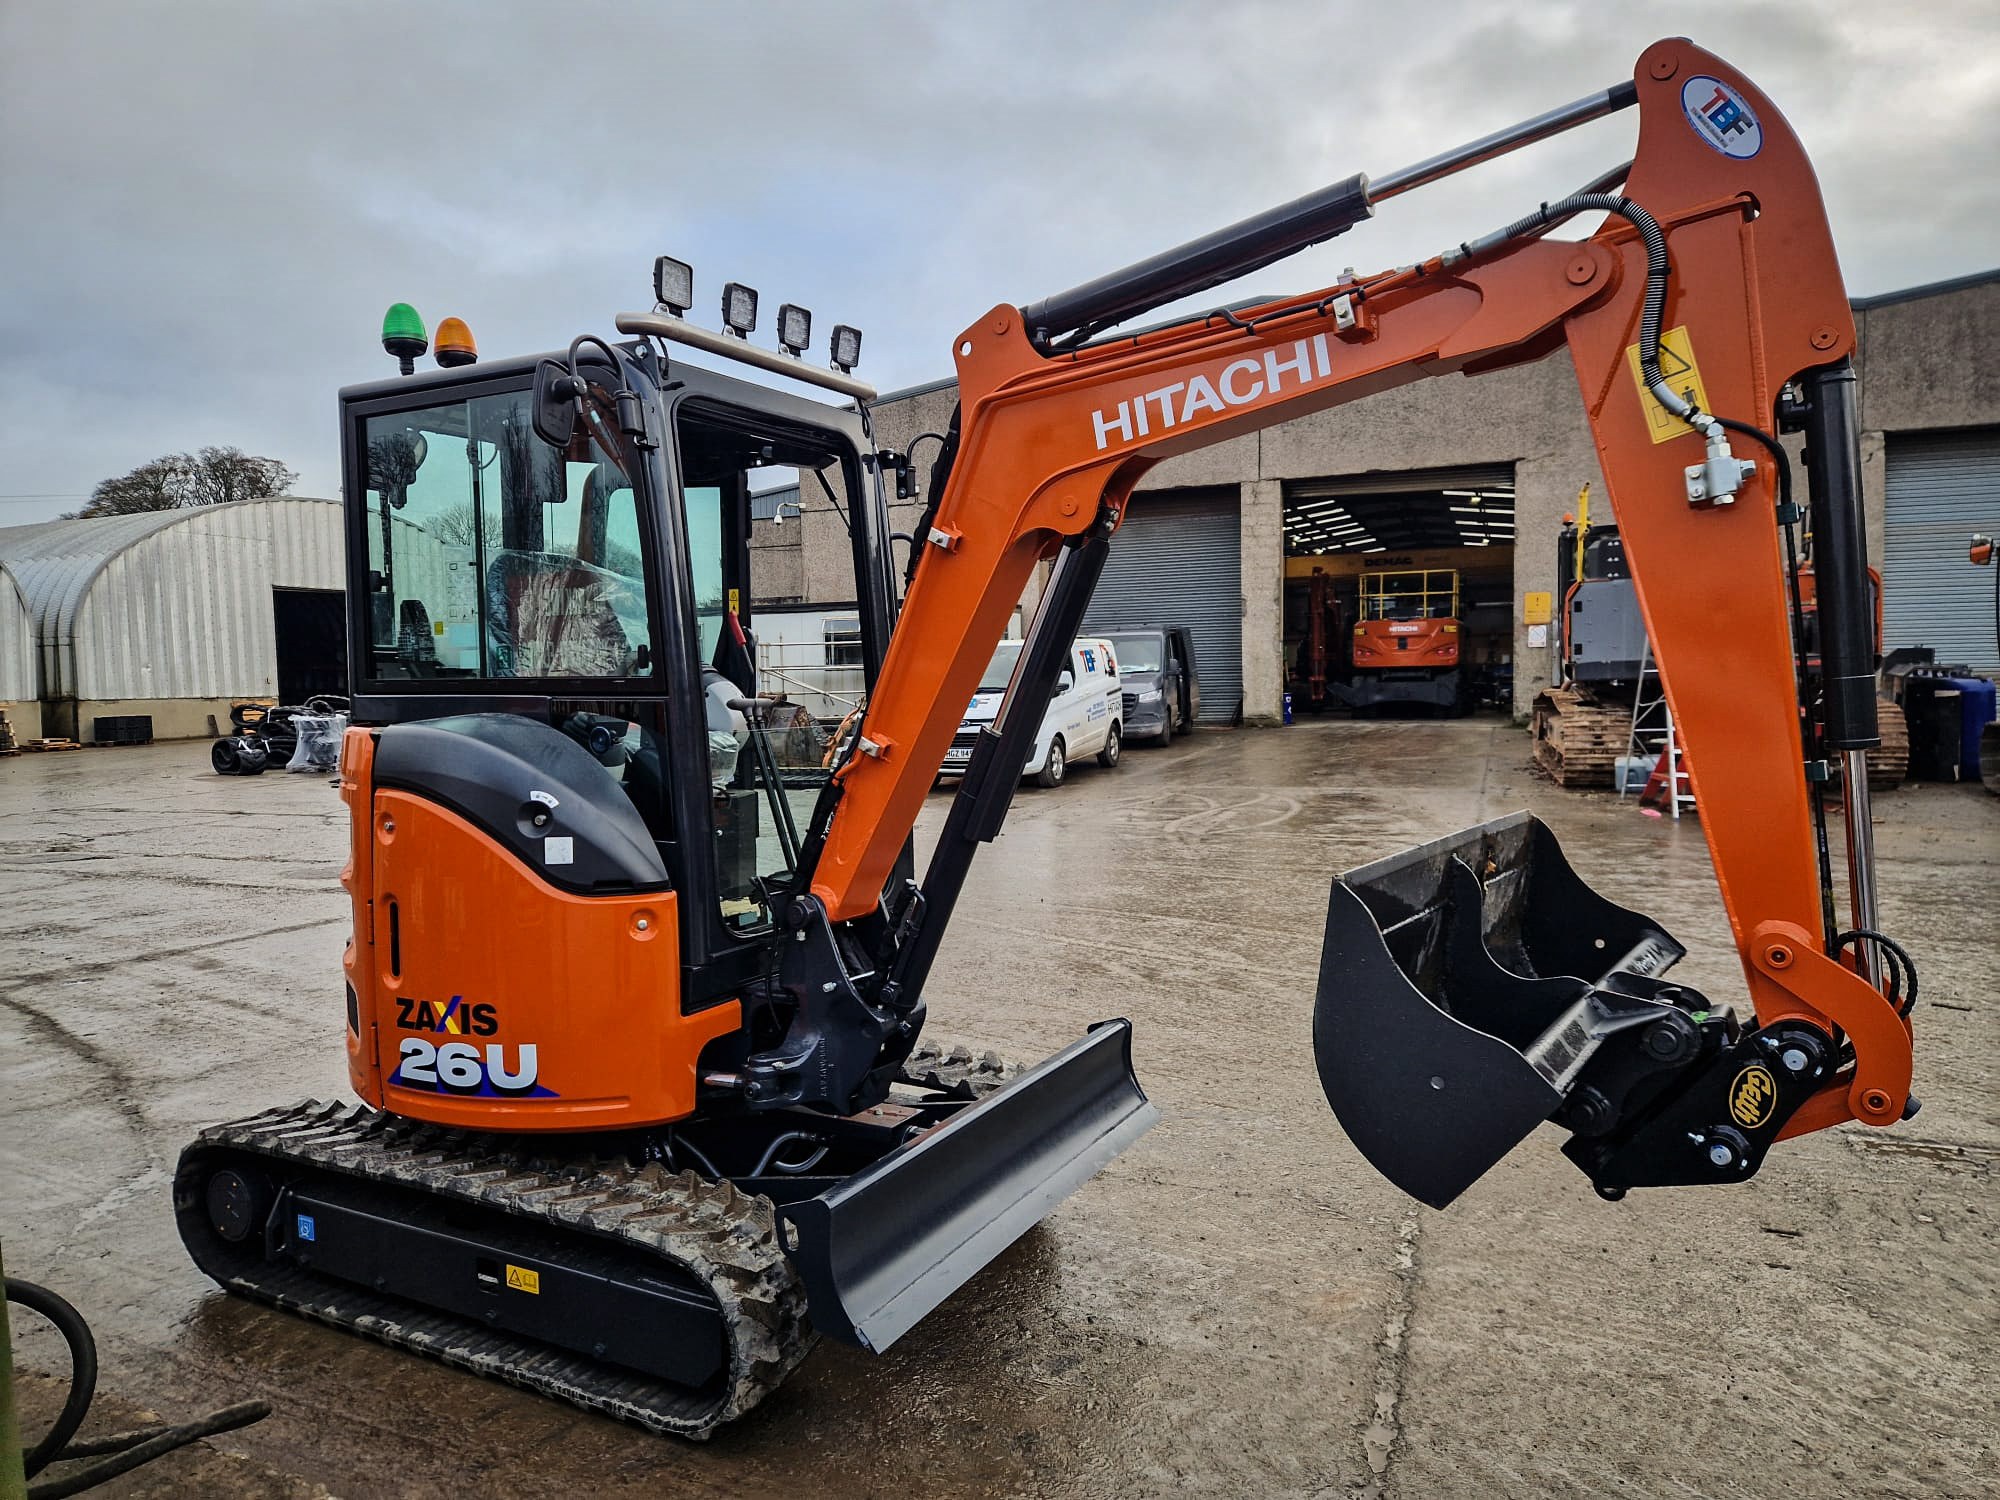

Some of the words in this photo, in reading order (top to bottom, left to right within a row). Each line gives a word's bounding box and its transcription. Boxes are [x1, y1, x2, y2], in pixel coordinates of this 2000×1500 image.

[1700, 86, 1754, 135] TBF
[1092, 333, 1332, 450] HITACHI
[1364, 556, 1413, 567] DEMAG
[396, 996, 498, 1036] ZAXIS
[400, 1037, 538, 1092] 26U
